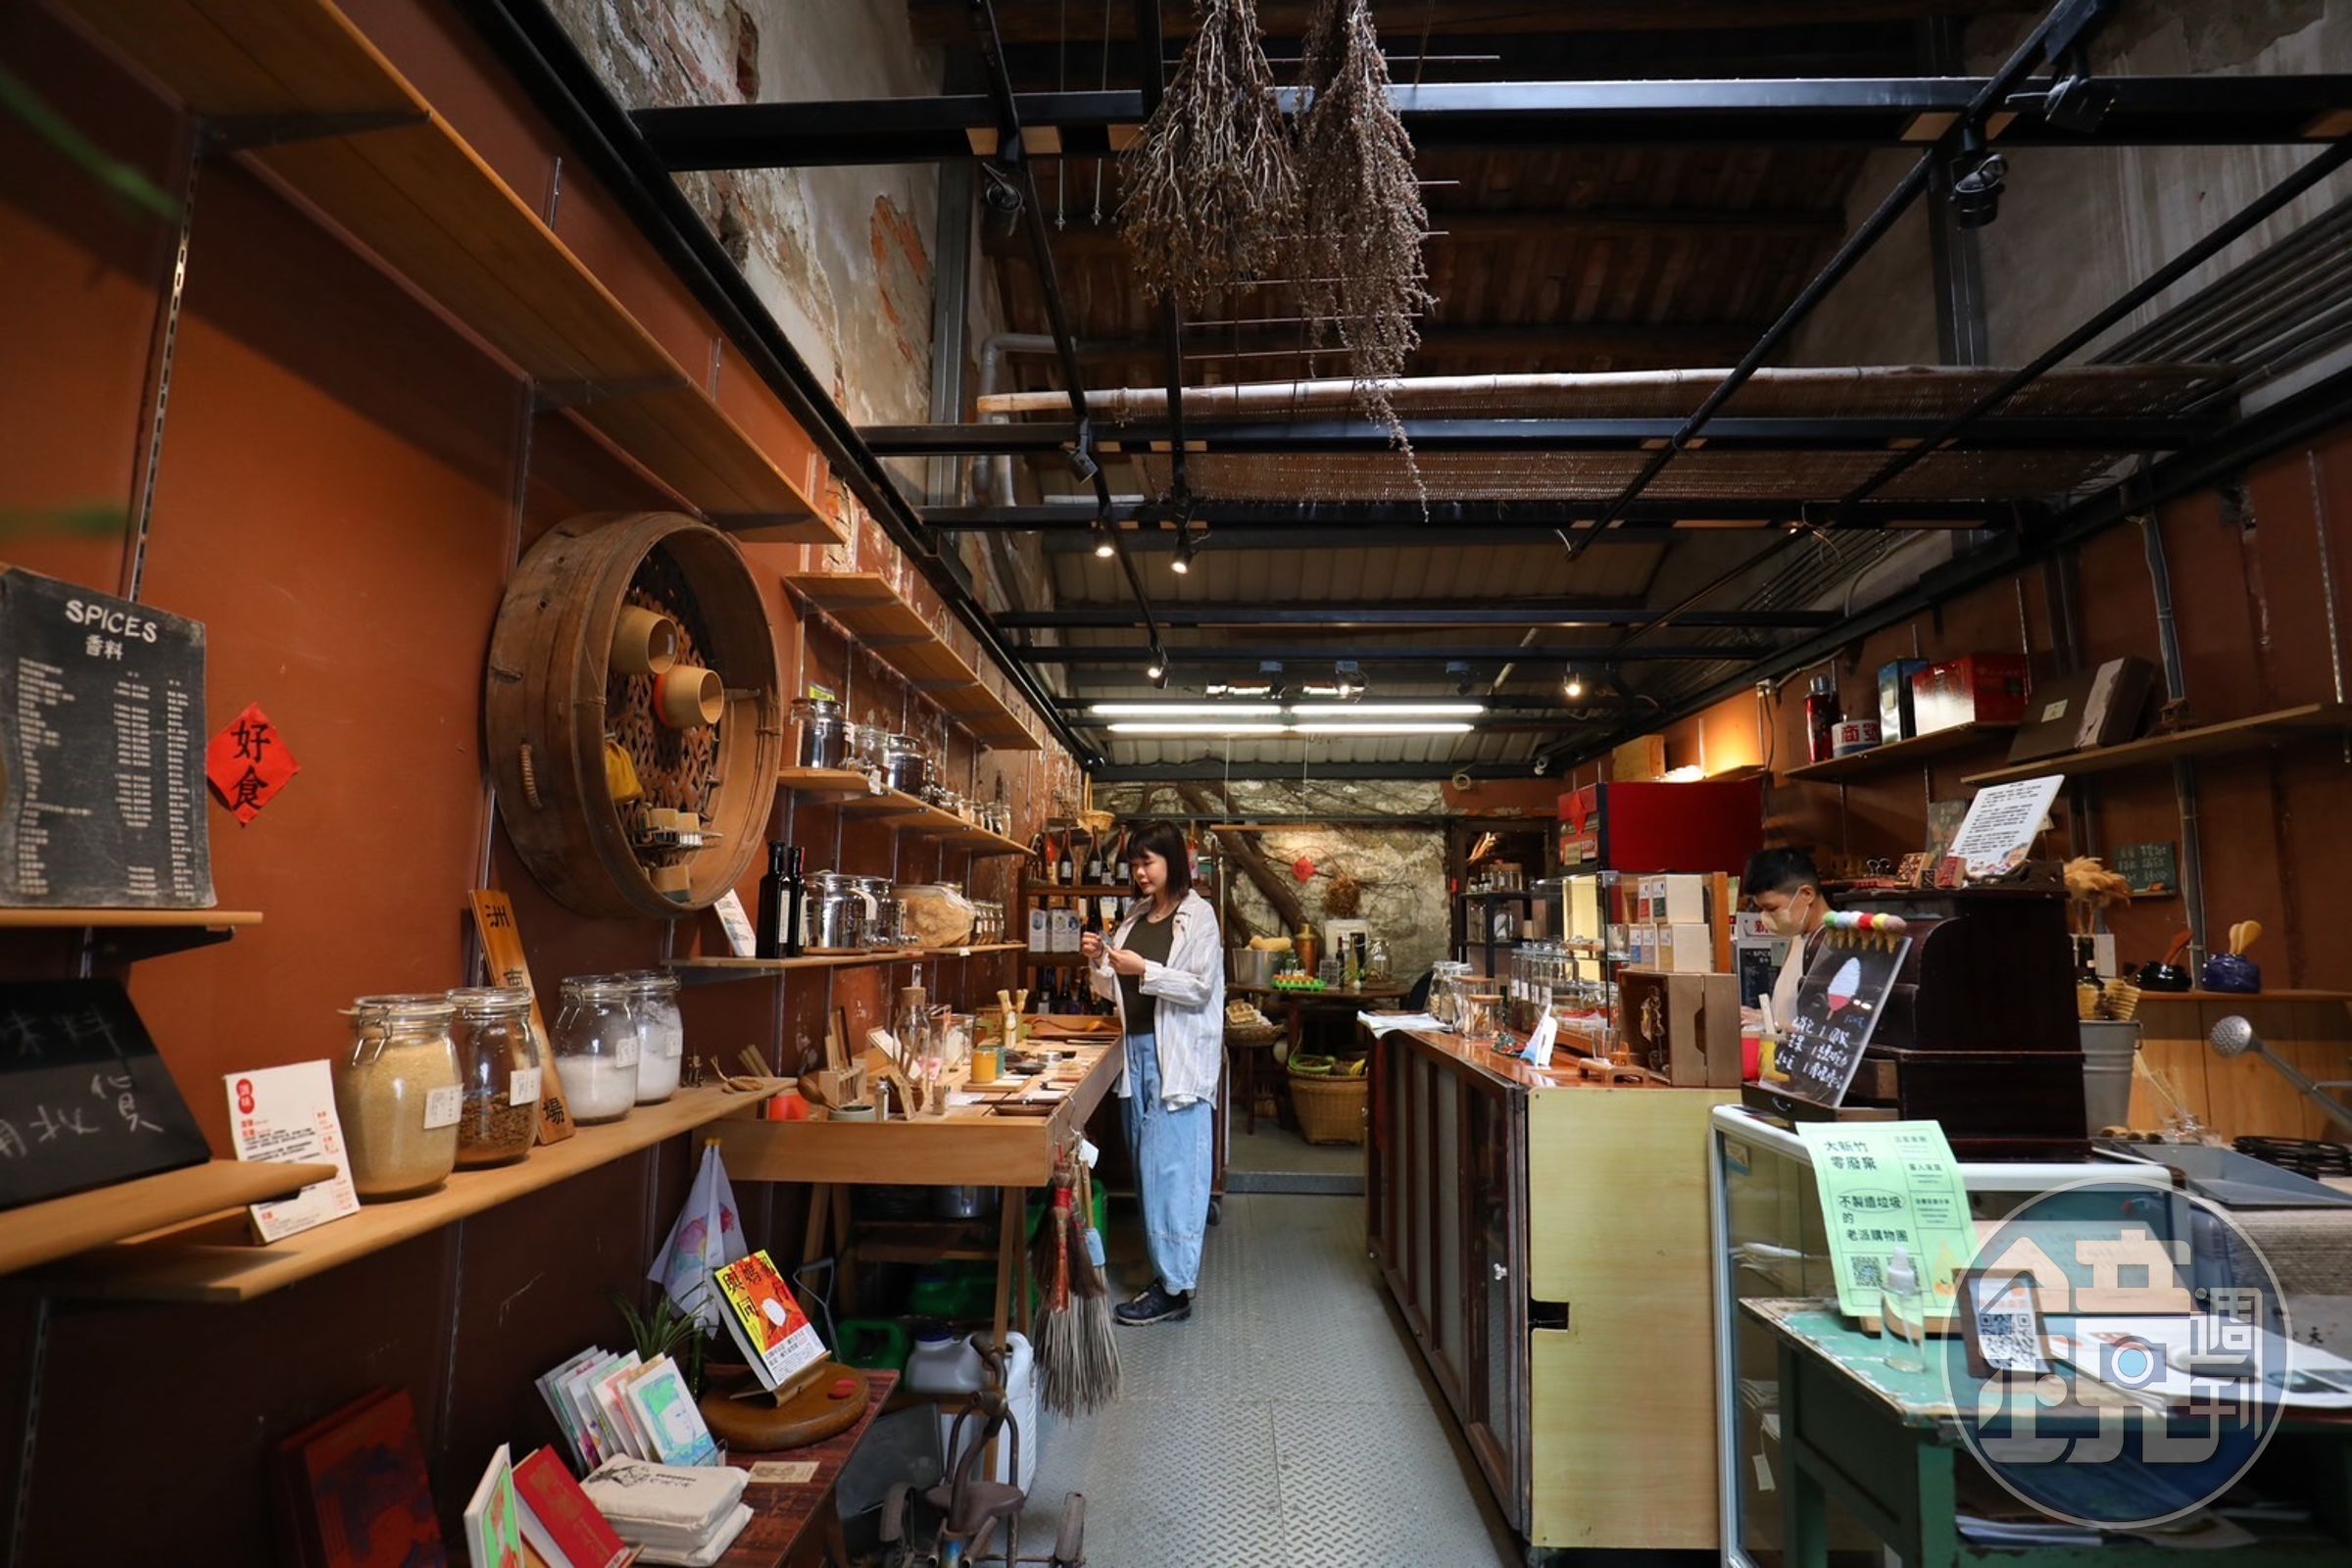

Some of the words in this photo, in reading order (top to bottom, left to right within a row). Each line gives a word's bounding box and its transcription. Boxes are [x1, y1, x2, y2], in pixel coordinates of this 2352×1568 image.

[65, 599, 158, 643] SPICES
[85, 634, 123, 661] 香料
[230, 719, 271, 811] 好食
[1824, 1140, 1869, 1153] 大新竹
[1831, 1156, 1877, 1170] 零廢棄
[1838, 1195, 1903, 1209] 不製造垃圾
[1842, 1211, 1854, 1224] 的
